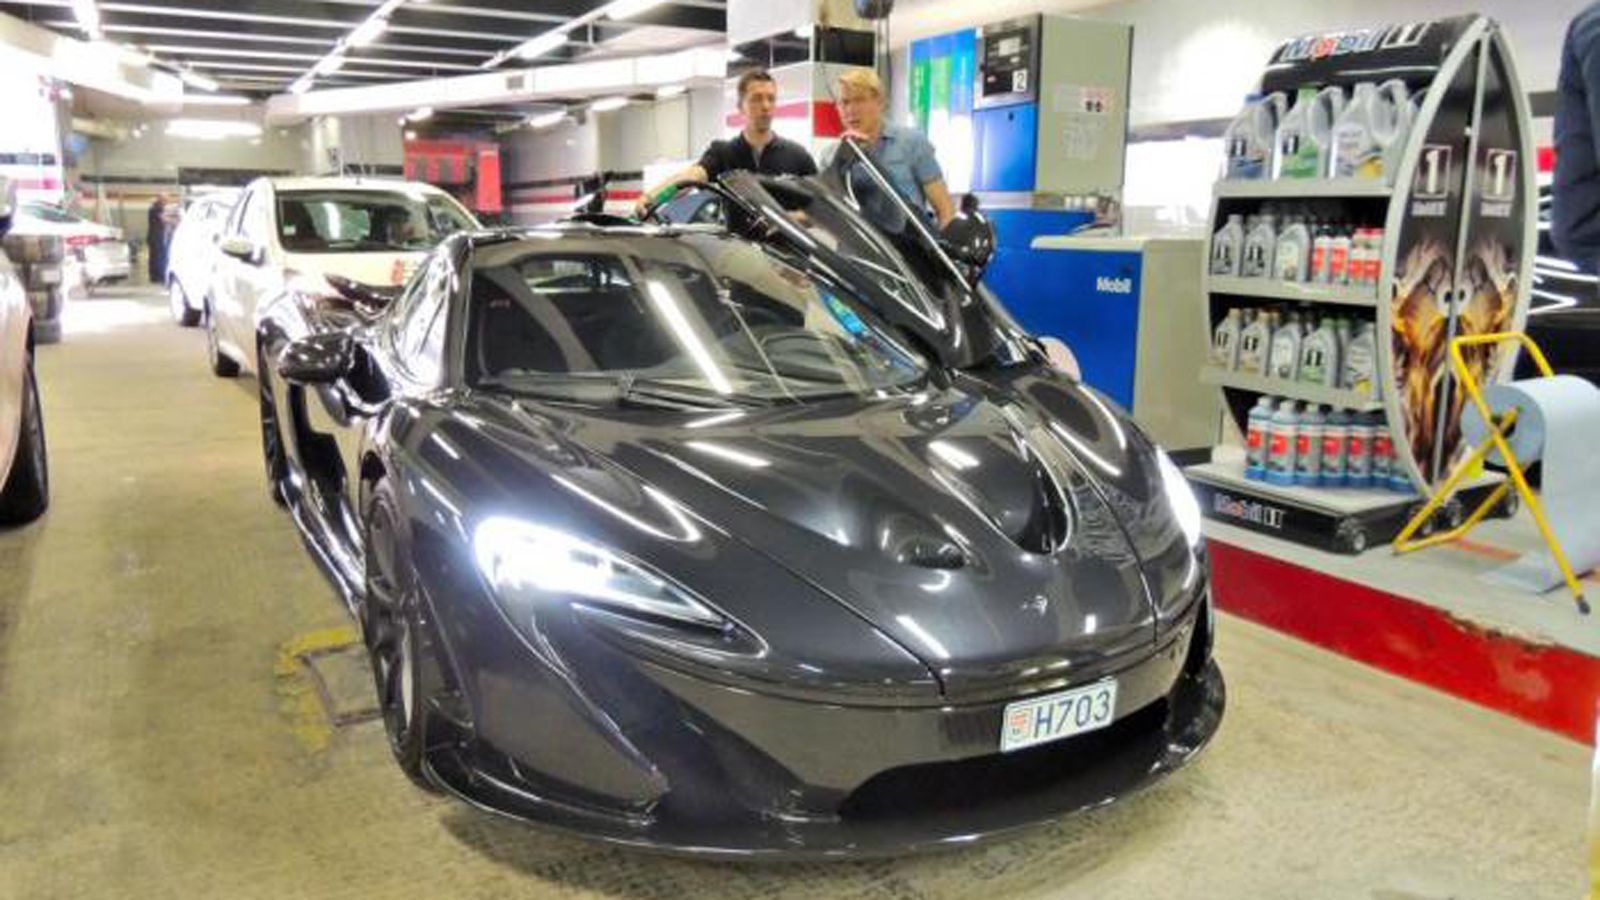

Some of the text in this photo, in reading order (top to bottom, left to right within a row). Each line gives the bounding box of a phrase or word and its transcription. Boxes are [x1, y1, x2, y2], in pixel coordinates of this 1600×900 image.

[1016, 72, 1025, 90] 2
[1426, 149, 1439, 193] 1
[1494, 154, 1507, 195] 1
[1096, 276, 1132, 294] Mobil
[1033, 689, 1111, 739] H703
